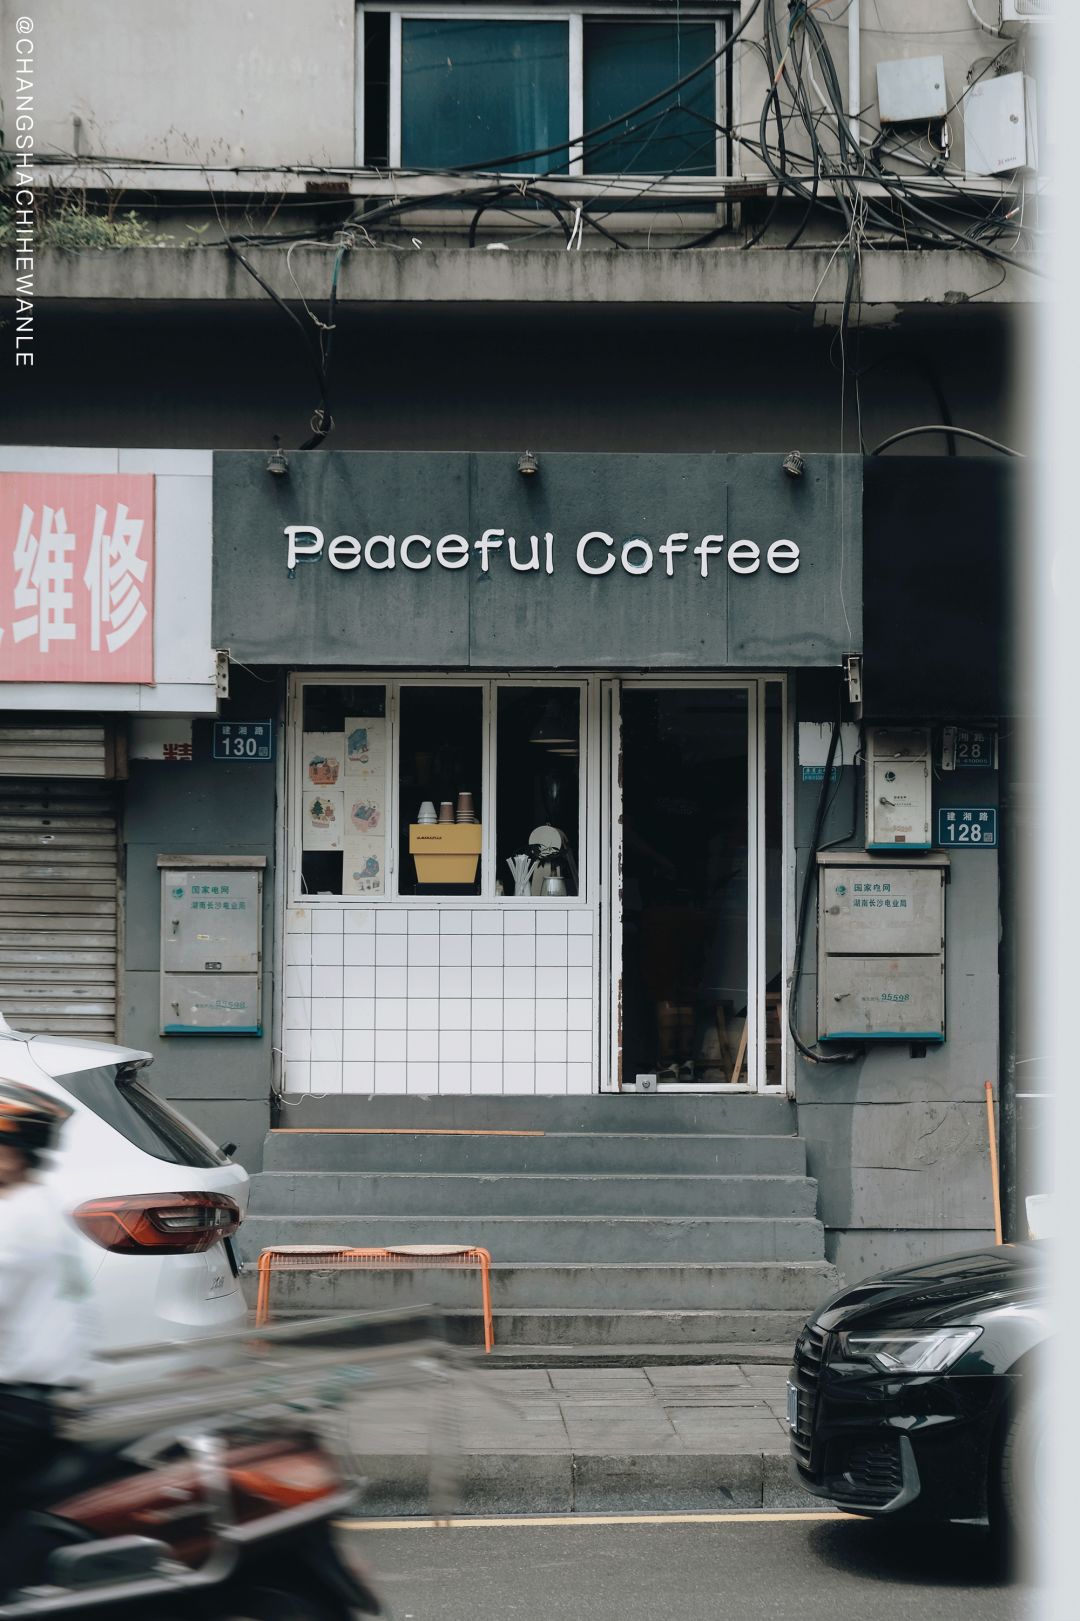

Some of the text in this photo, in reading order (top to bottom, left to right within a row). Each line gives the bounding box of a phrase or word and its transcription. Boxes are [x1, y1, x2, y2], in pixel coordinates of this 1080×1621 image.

[284, 525, 801, 578] Peaceful Coffee
[0, 502, 148, 653] 维修
[222, 737, 257, 756] 130
[959, 743, 981, 758] 28
[946, 811, 989, 821] 建湘路
[947, 823, 982, 842] 128
[191, 885, 230, 895] 国家电网
[853, 883, 891, 892] 国家电网
[853, 898, 907, 908] 湖南长沙电业局
